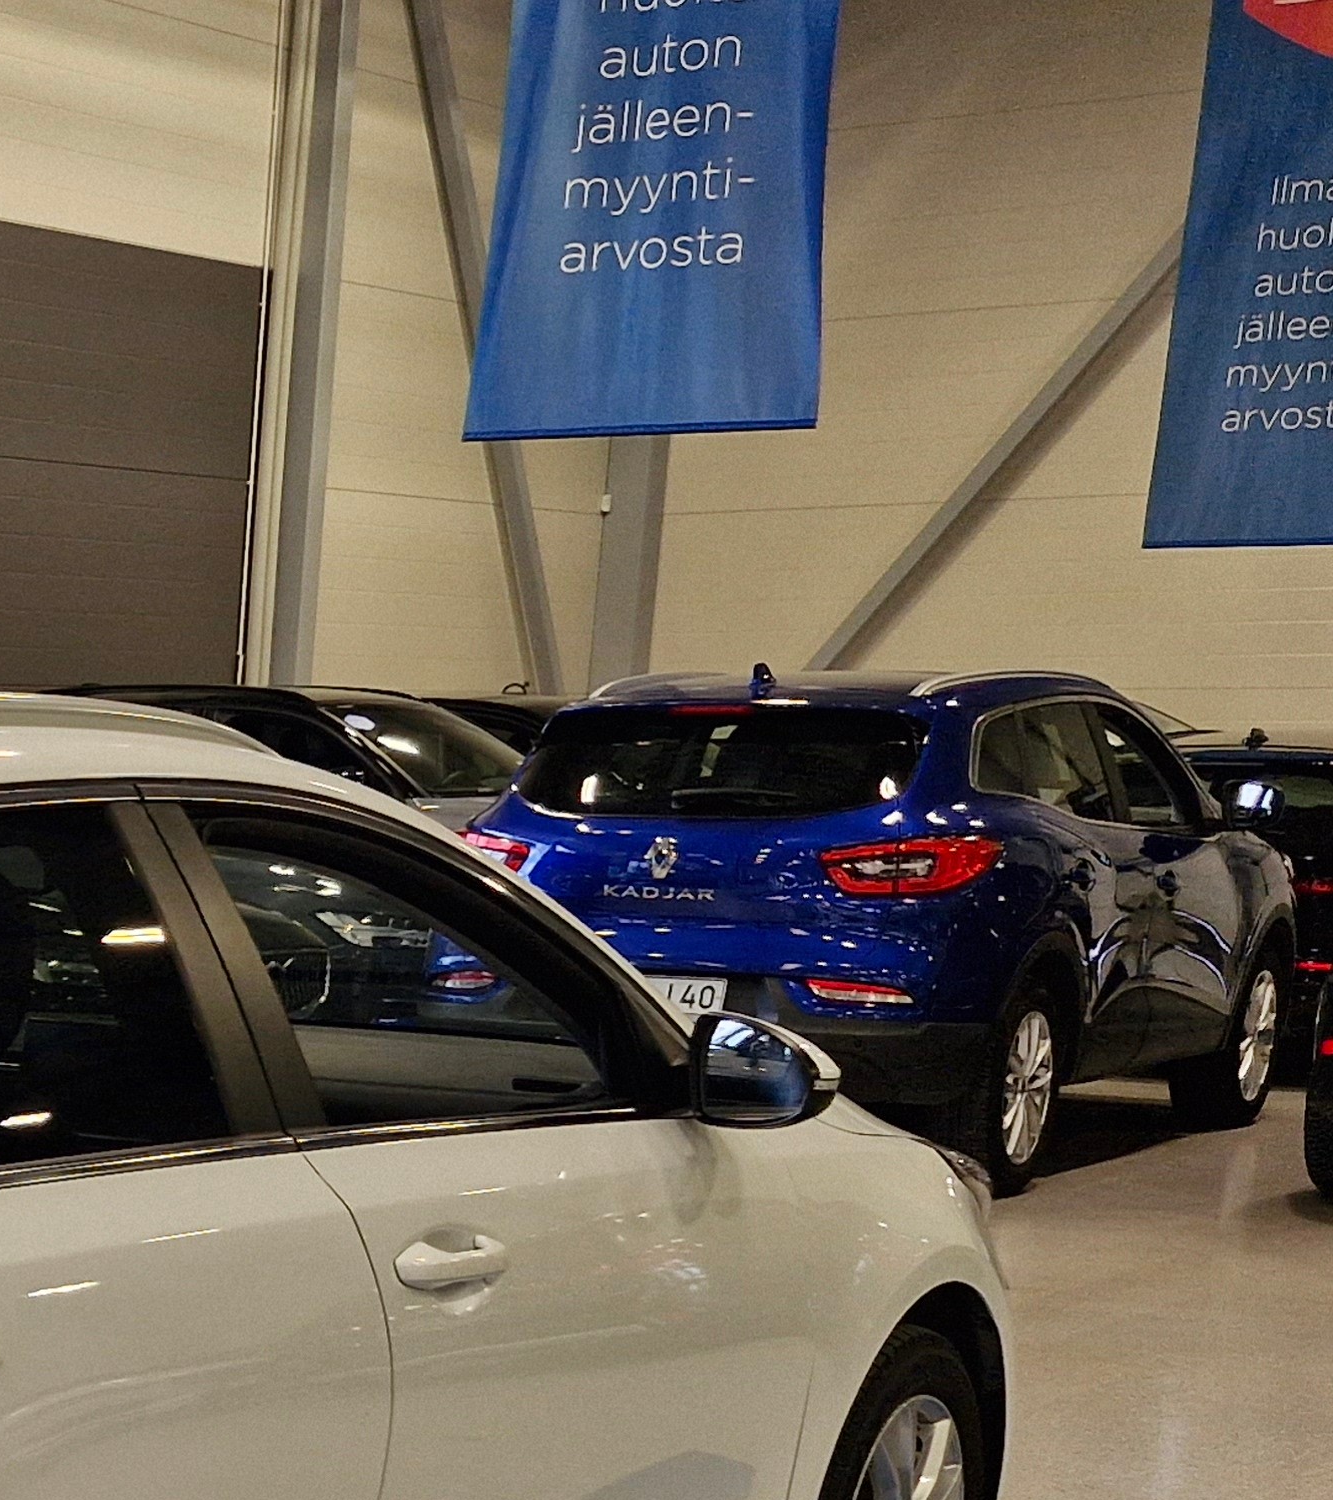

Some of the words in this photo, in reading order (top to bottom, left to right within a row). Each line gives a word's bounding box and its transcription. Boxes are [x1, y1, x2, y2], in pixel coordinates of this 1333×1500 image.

[599, 34, 743, 79] auton
[570, 100, 755, 153] jälleen-
[563, 156, 756, 216] myynti-
[559, 226, 745, 273] arvosta
[1226, 360, 1333, 392] myyn
[602, 884, 716, 901] KADJAR
